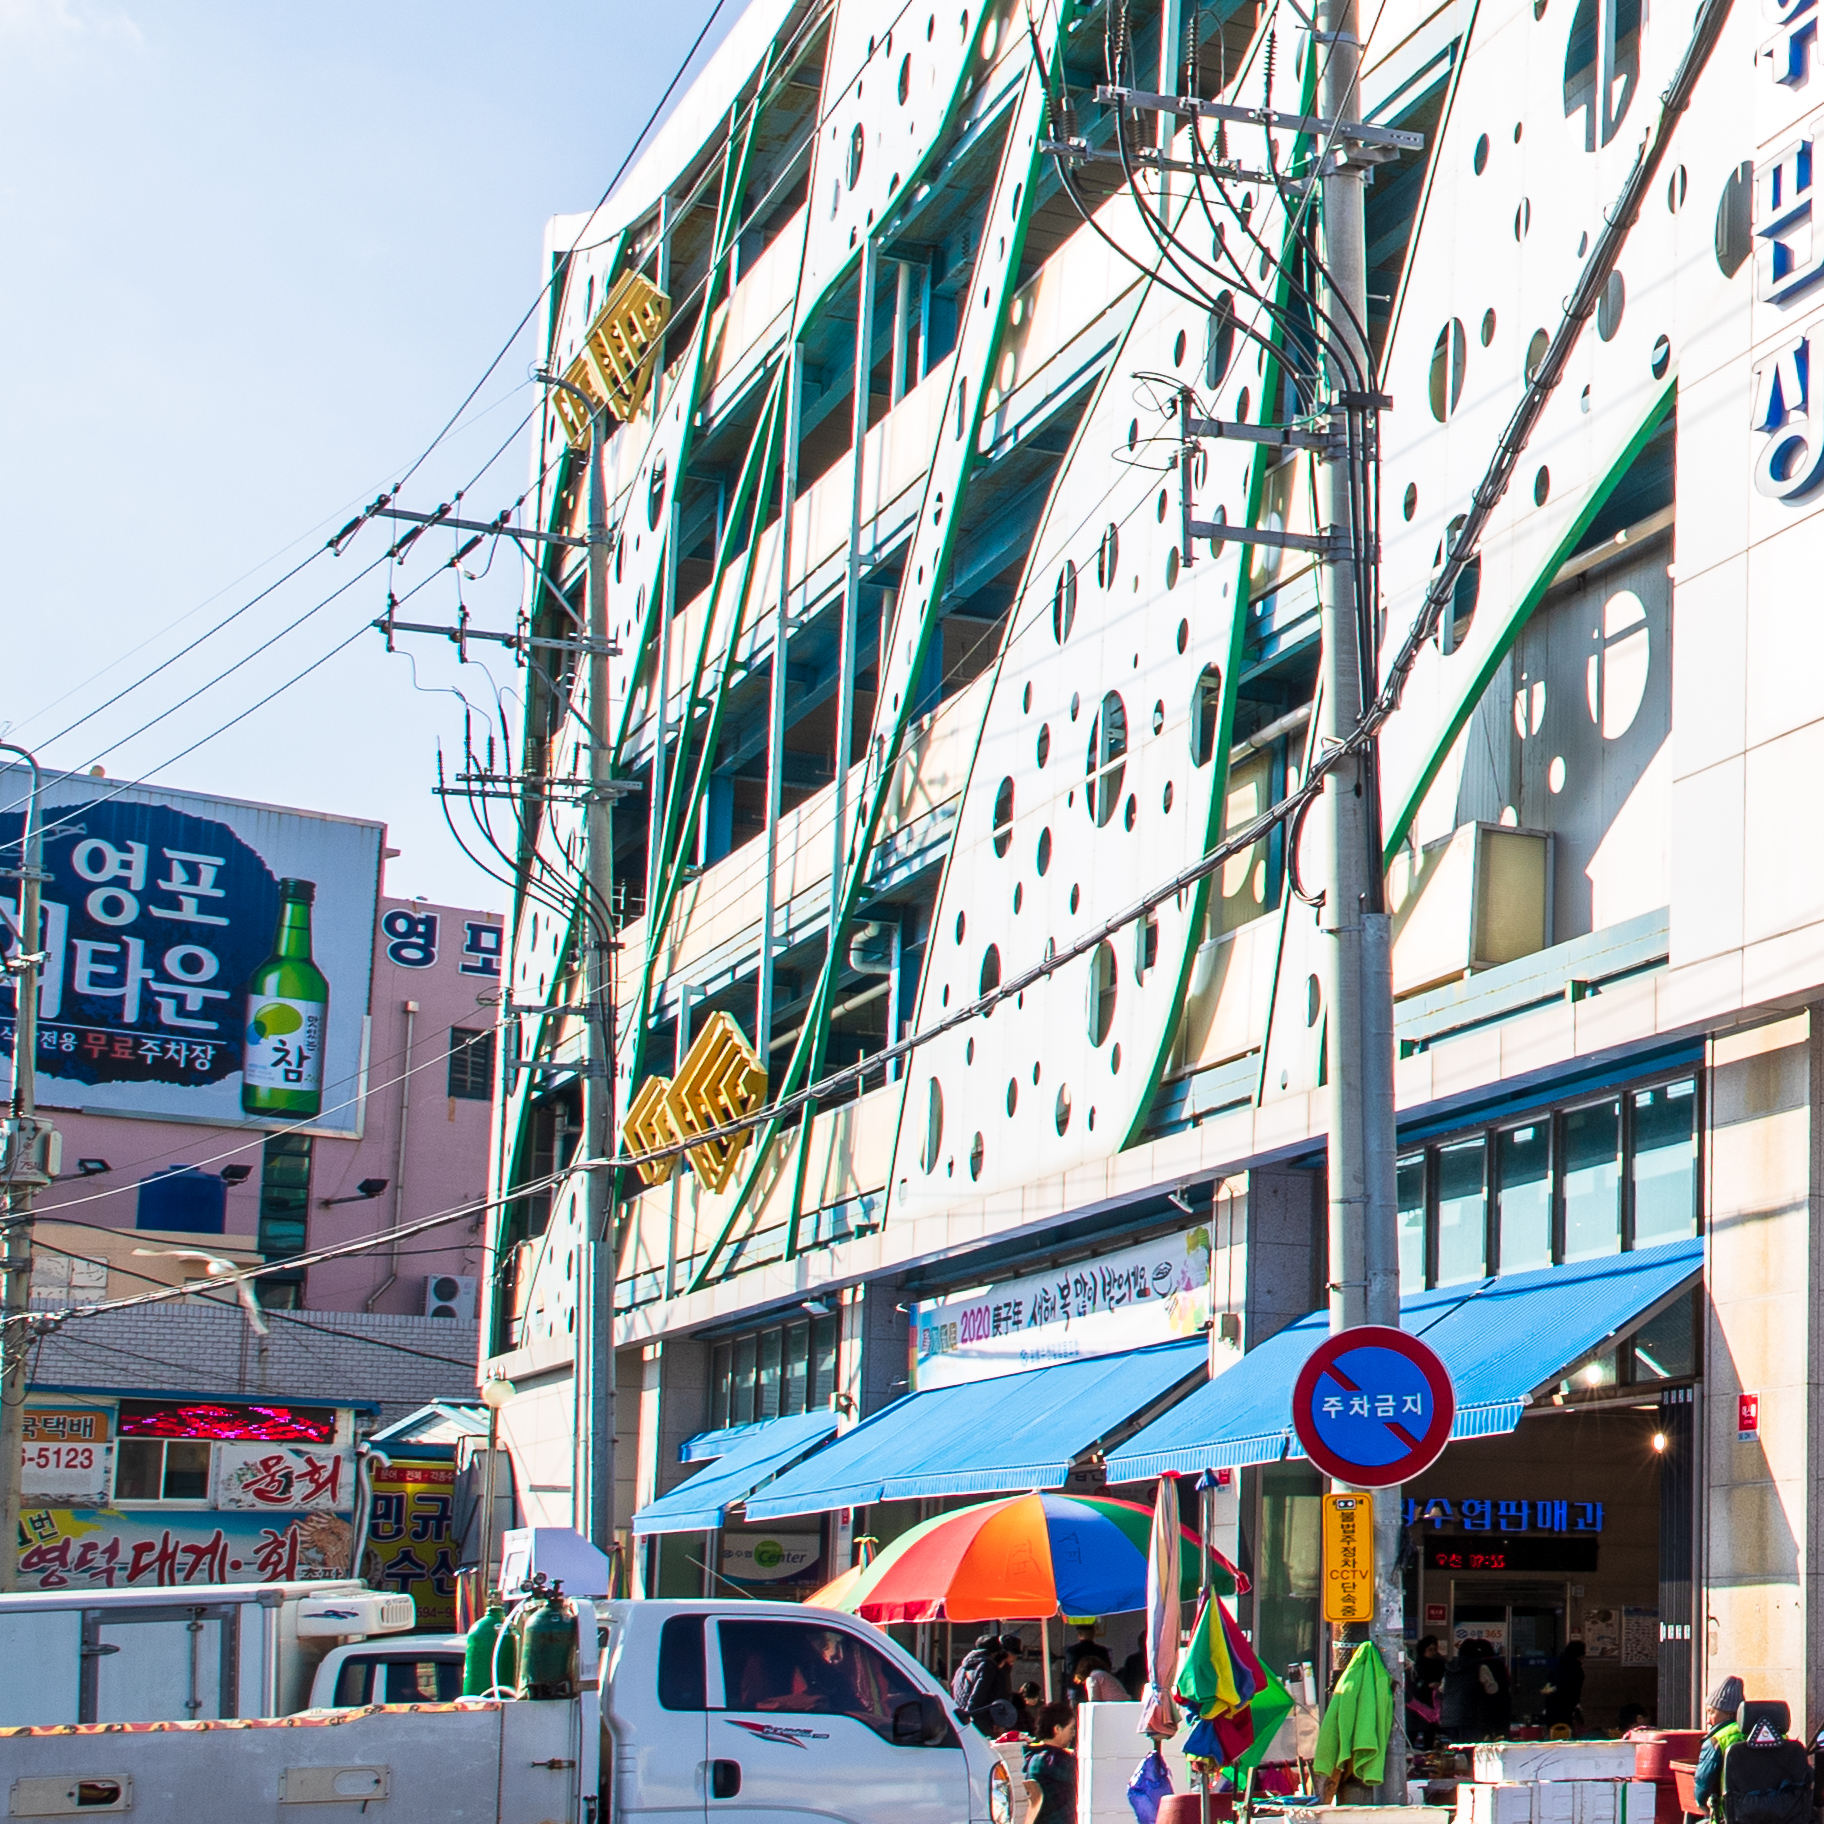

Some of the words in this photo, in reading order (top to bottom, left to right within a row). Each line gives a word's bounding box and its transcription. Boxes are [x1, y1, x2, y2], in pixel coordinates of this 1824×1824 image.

[72, 838, 230, 926] 영포
[40, 1030, 78, 1053] 전용
[83, 1032, 216, 1070] 무료주차장
[270, 1038, 312, 1082] 참
[961, 1304, 991, 1344] 2020
[1322, 1392, 1423, 1419] 주차금지
[241, 1455, 342, 1503] 물회
[371, 1491, 452, 1542] 민규
[757, 1549, 808, 1564] Center
[1341, 1512, 1357, 1568] 불법주정차
[1330, 1569, 1369, 1580] CCTV
[1341, 1582, 1357, 1617] 단속중
[1485, 1629, 1503, 1639] 365
